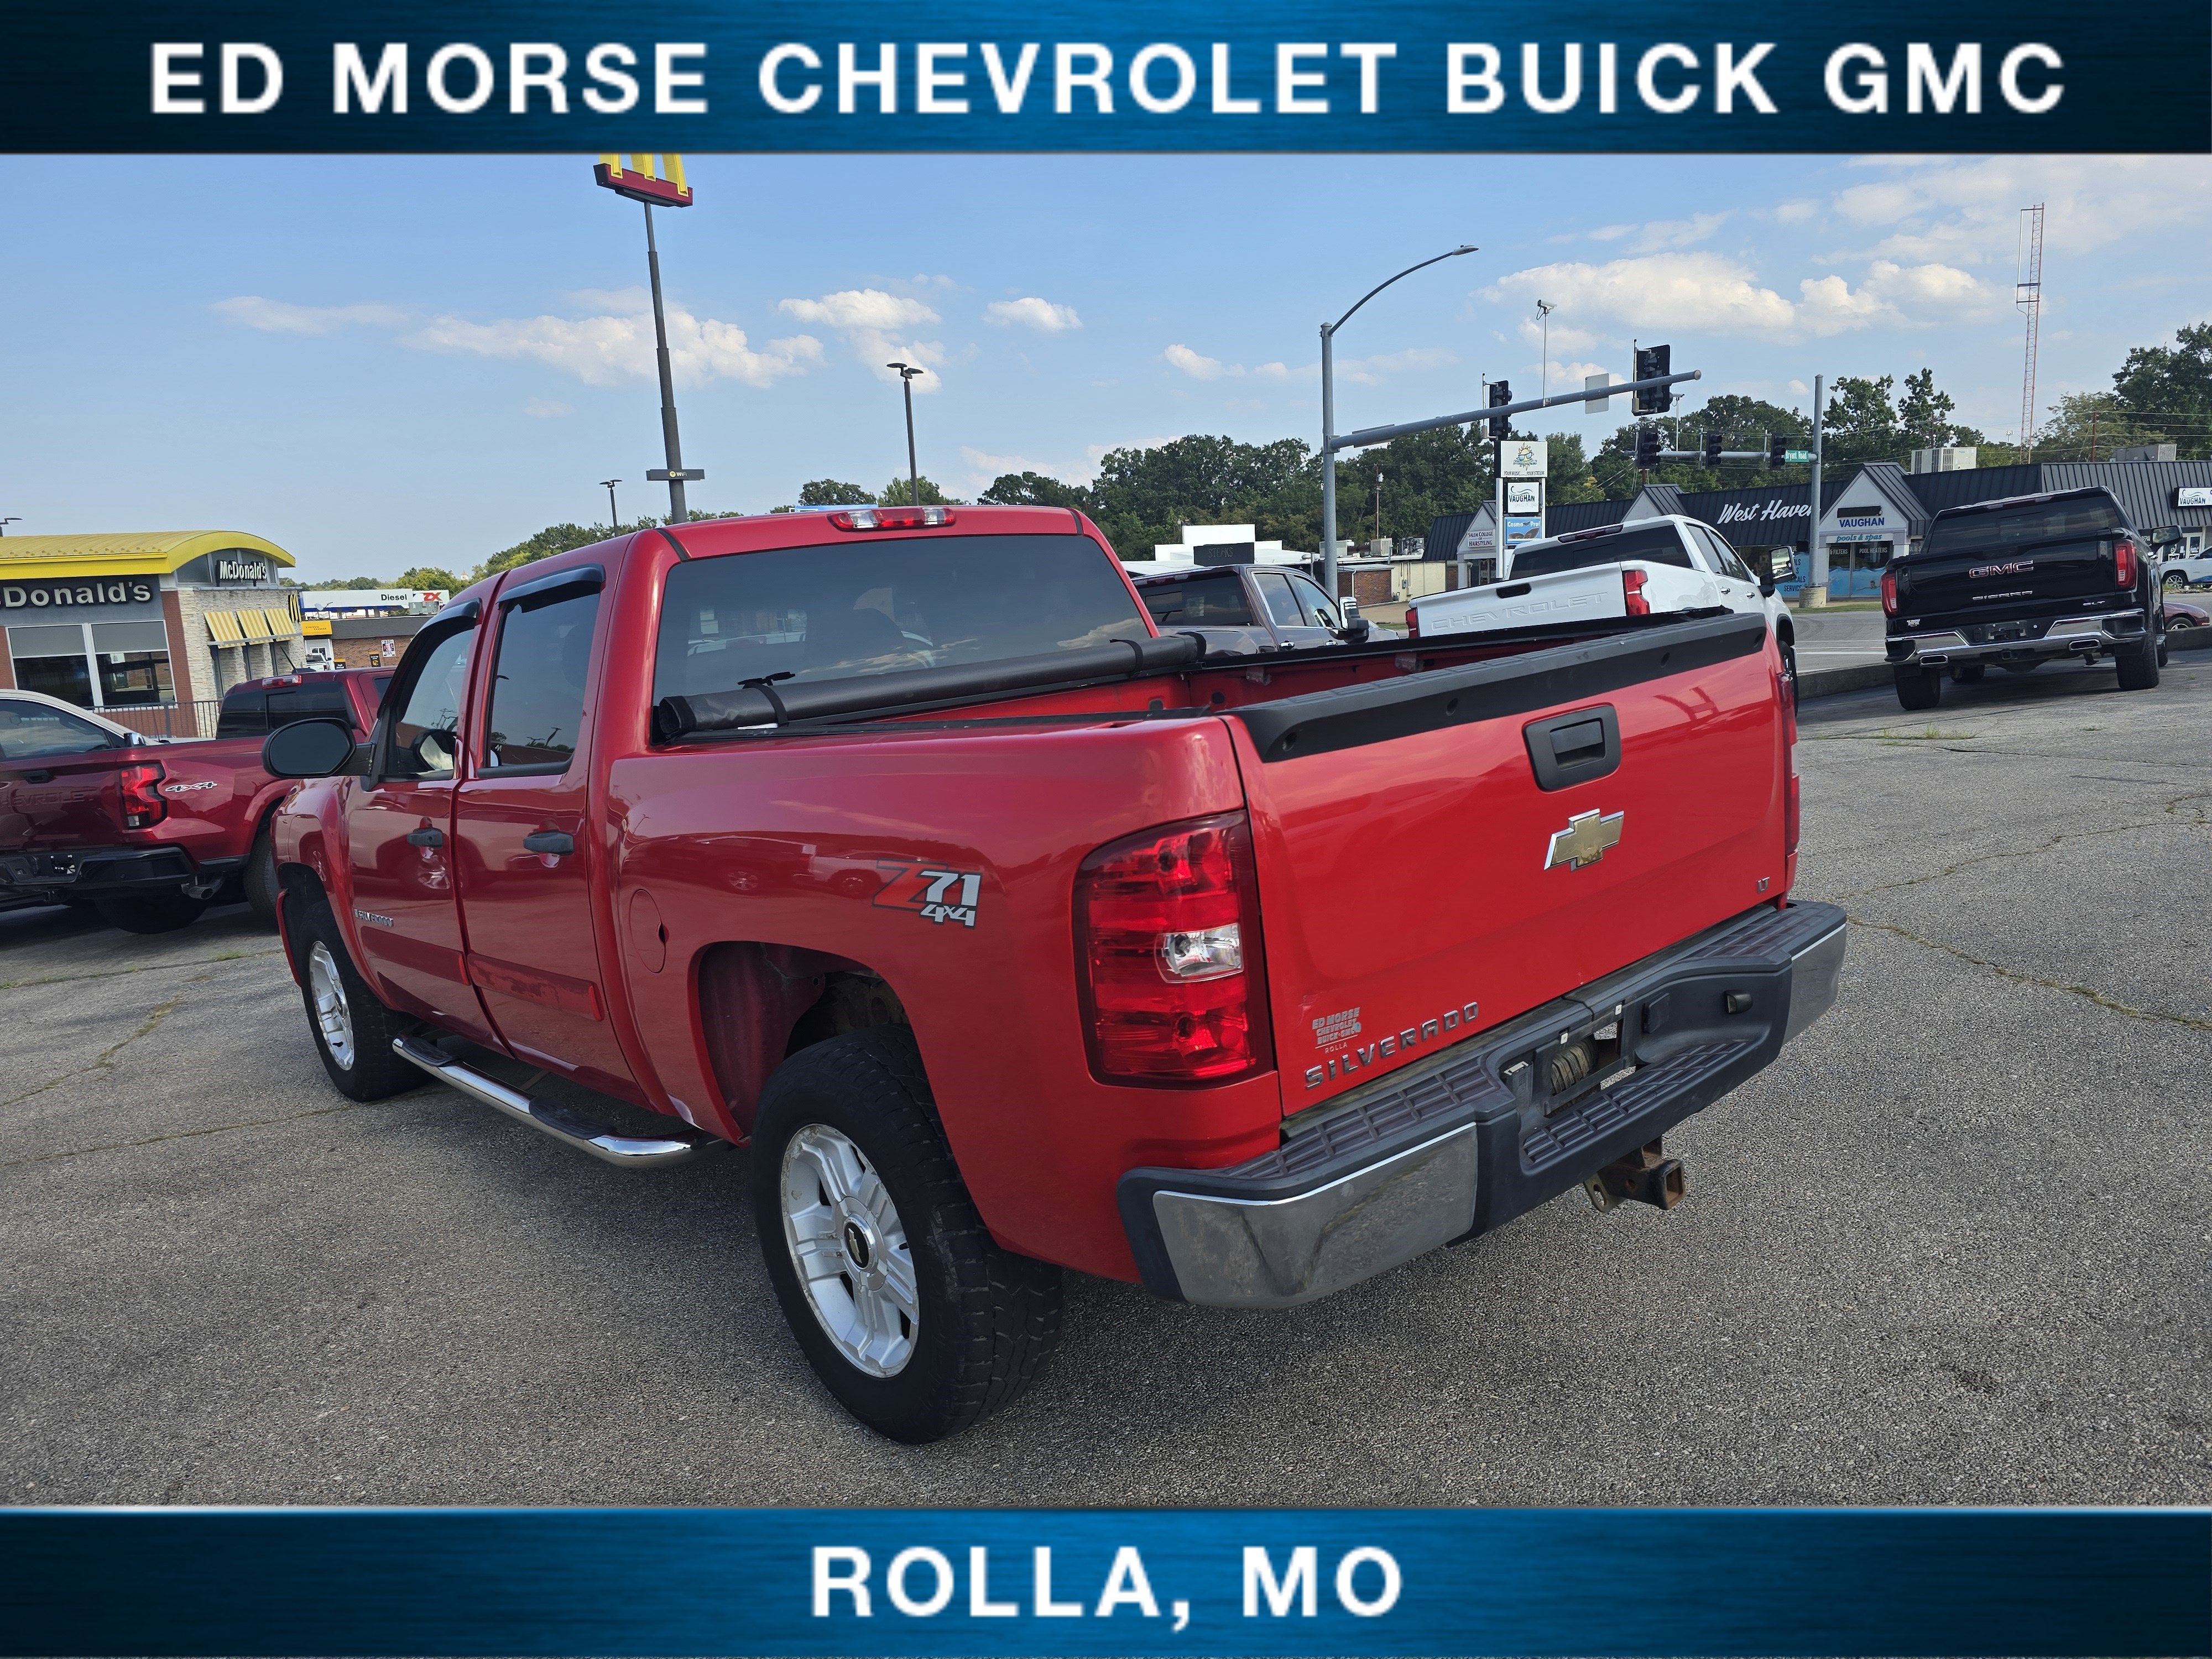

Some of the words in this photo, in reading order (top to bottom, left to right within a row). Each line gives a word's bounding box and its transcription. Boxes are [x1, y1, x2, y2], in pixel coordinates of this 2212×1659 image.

[1786, 450, 1797, 461] Bryant
[1798, 451, 1807, 460] Road
[1717, 503, 1760, 524] West
[1760, 499, 1820, 521] Have
[1839, 518, 1885, 528] VAUGHAN
[1836, 535, 1857, 543] pools
[1864, 534, 1882, 542] spas
[220, 561, 267, 580] McDonald's
[1969, 560, 2034, 578] GMC
[1973, 590, 2033, 601] SIERRA
[1431, 592, 1608, 631] CHEVROLET
[872, 857, 983, 907] Z71
[1757, 877, 1770, 894] LT
[1312, 1018, 1325, 1029] ED
[1327, 1007, 1360, 1026] MORSE
[1317, 1018, 1357, 1036] CHEVROLET
[1304, 1001, 1479, 1089] SILVERADO
[1325, 1042, 1348, 1053] ROLLA
